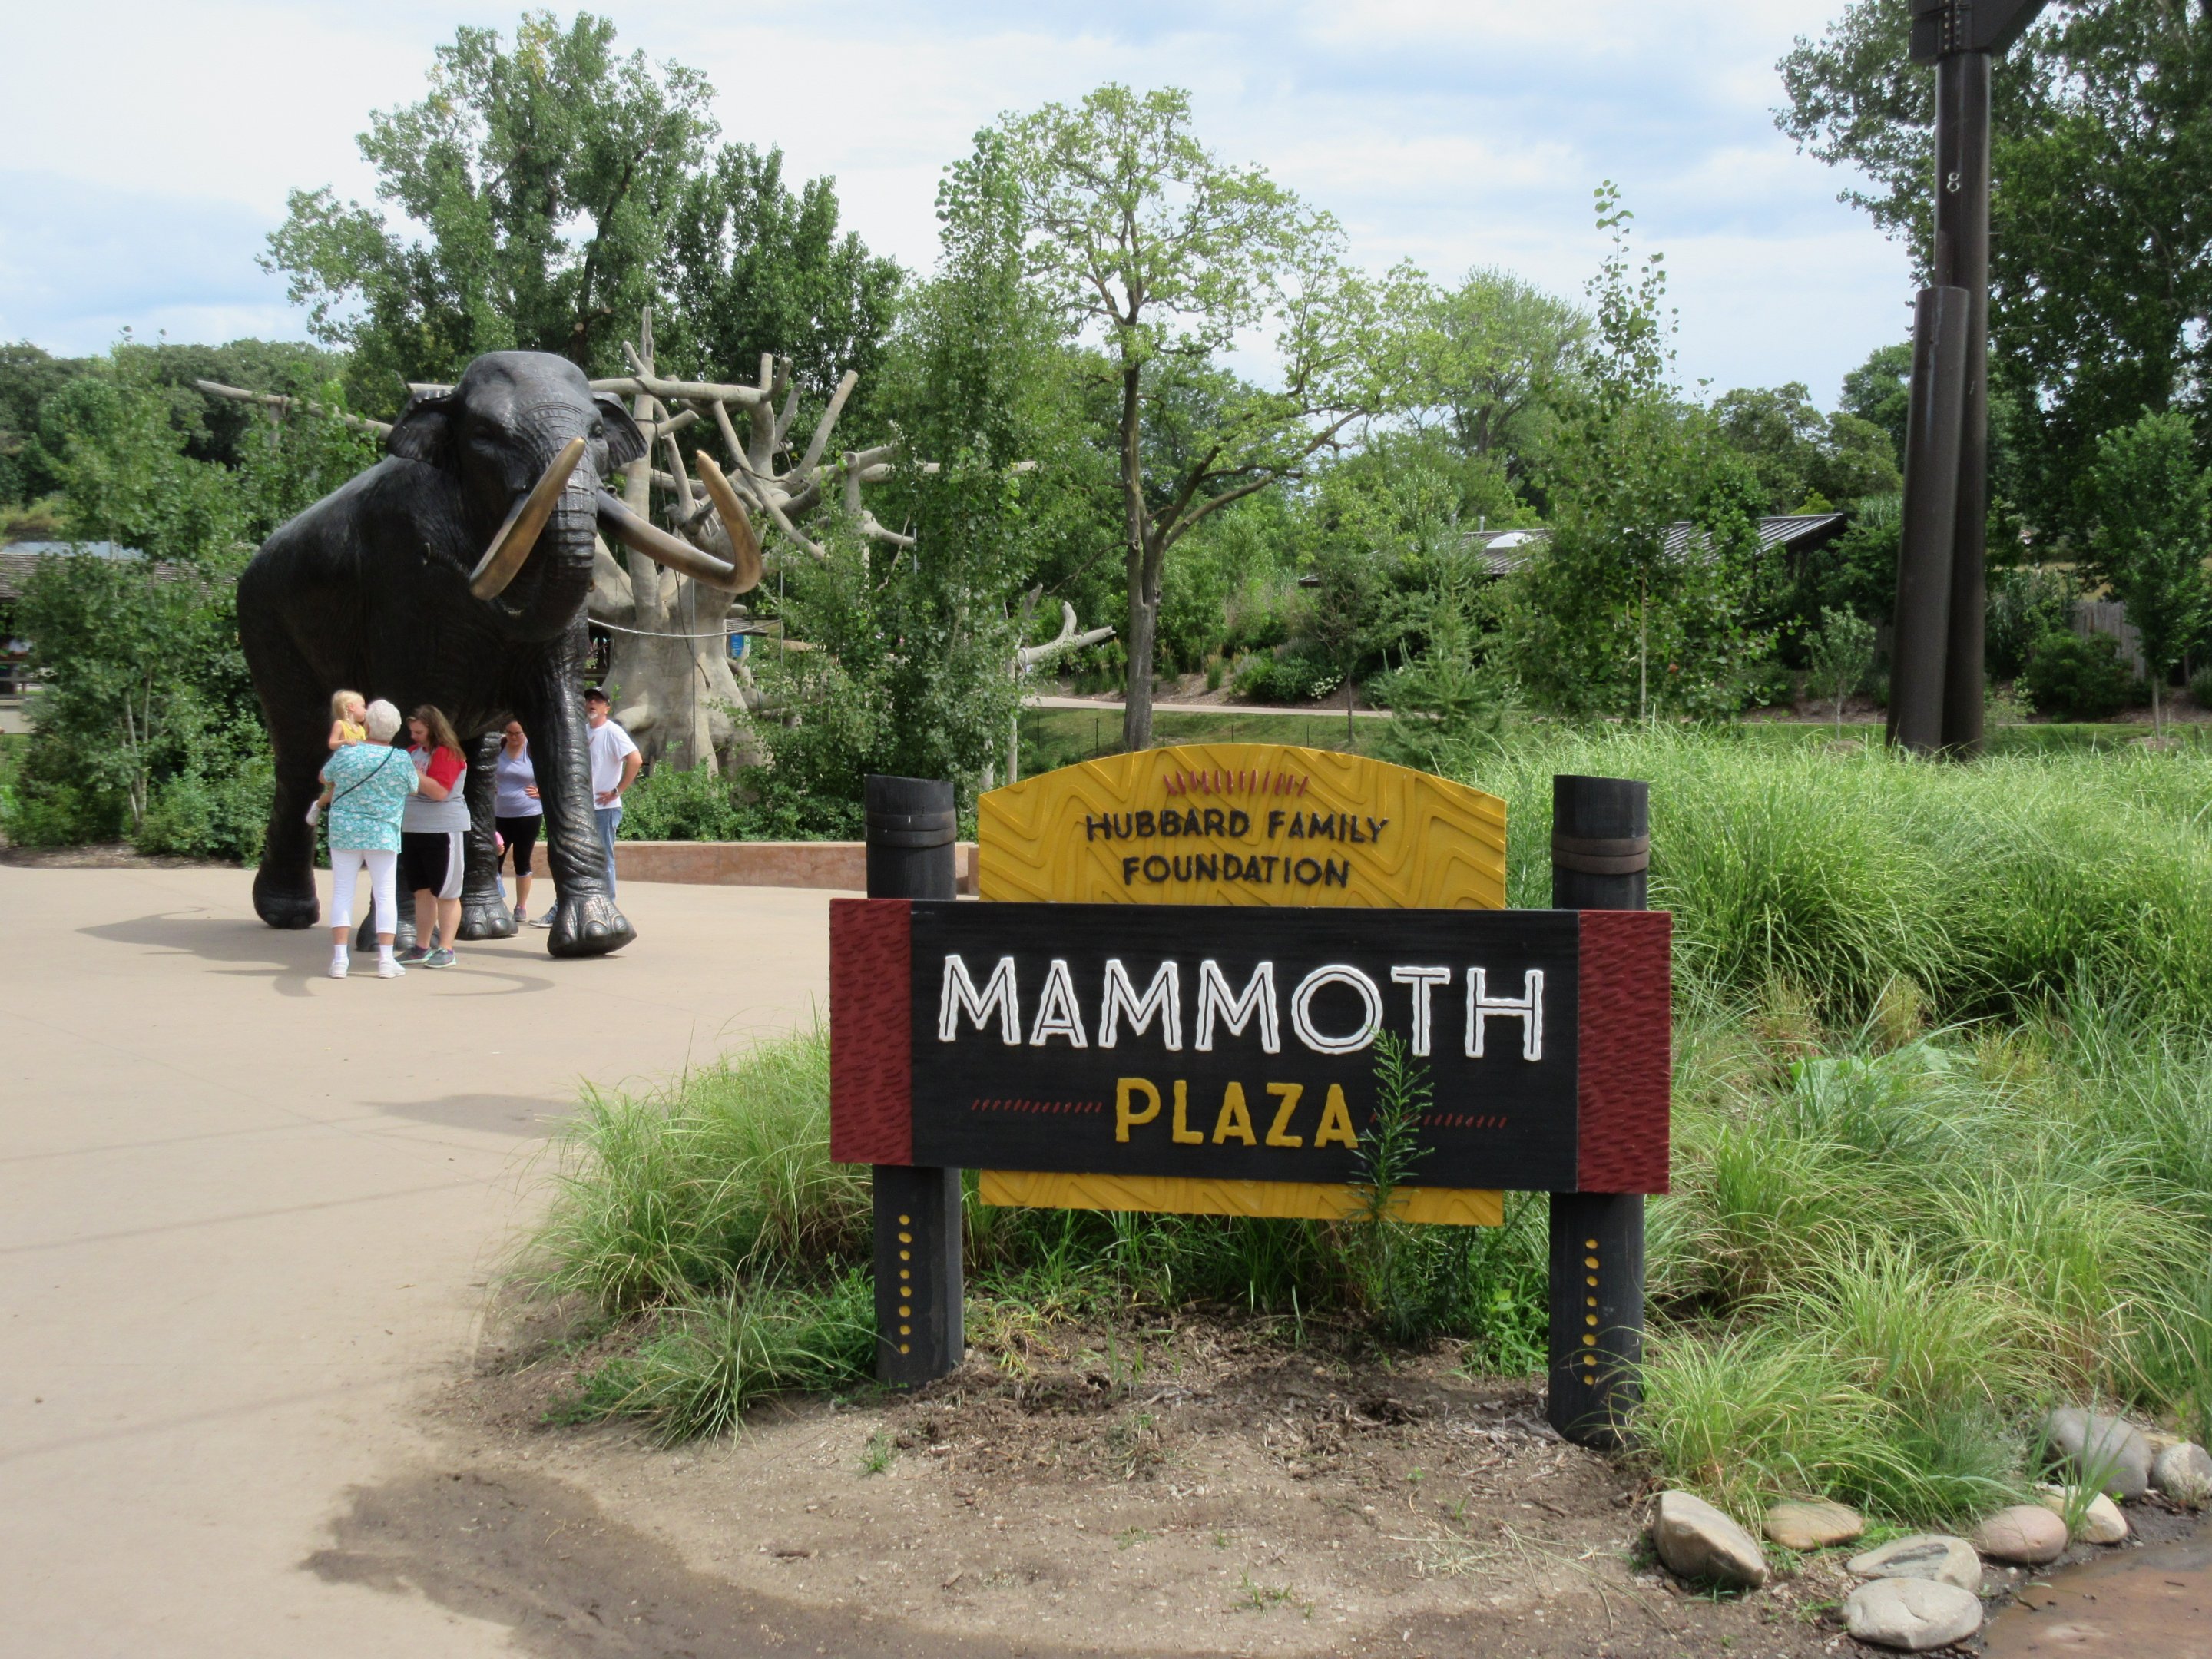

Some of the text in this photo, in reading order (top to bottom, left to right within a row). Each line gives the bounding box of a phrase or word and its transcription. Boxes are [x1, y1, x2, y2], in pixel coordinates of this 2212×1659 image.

[1086, 807, 1389, 843] HUBBARD FAMILY
[1122, 853, 1349, 888] FOUNDATION
[938, 954, 1544, 1062] MAMMOTH
[1115, 1077, 1358, 1149] PLAZA
